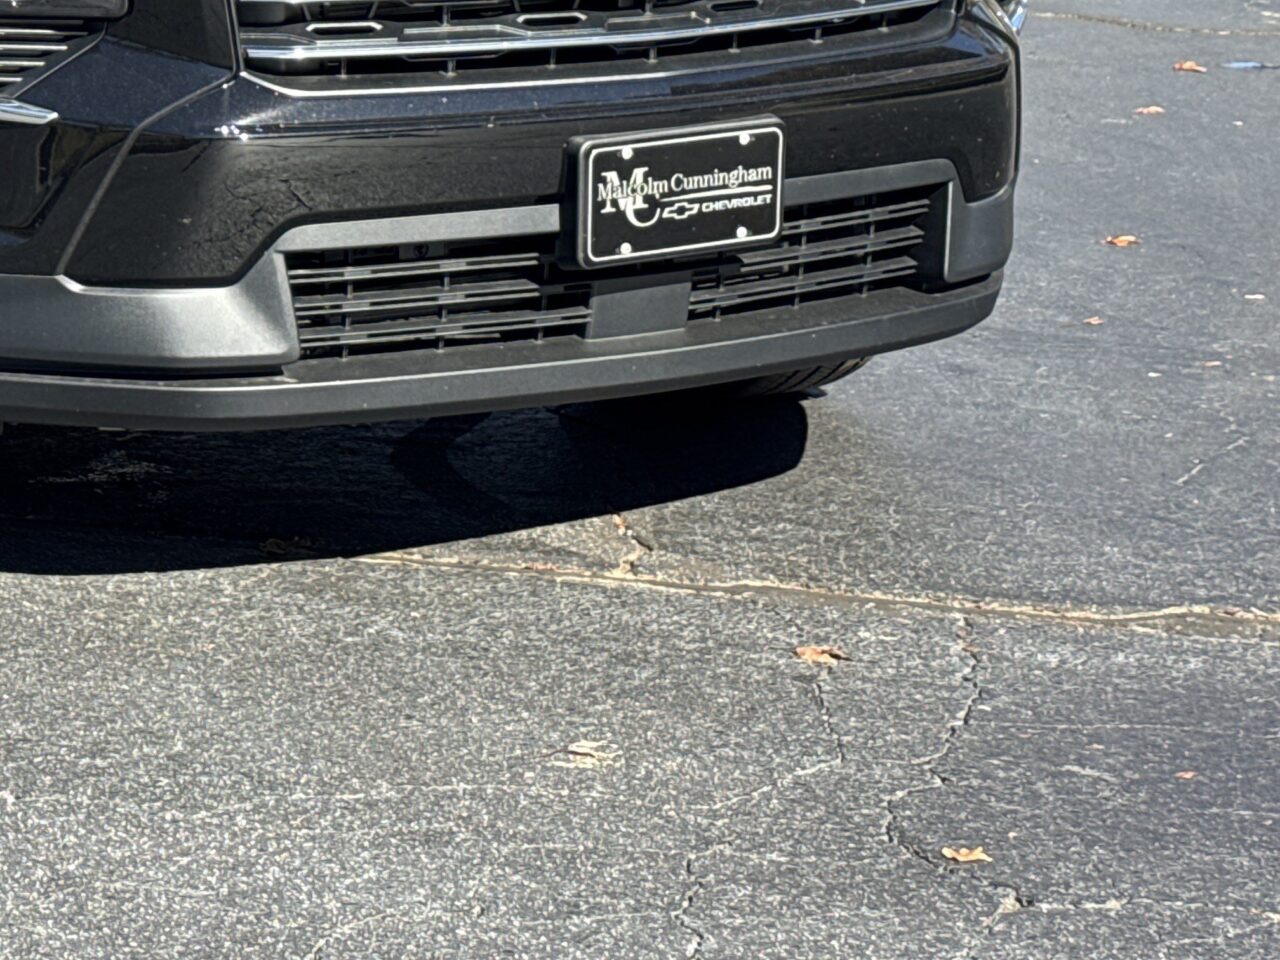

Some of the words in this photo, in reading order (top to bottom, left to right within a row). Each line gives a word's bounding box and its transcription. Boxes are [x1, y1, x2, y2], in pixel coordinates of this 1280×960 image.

[597, 176, 669, 202] Malcolm
[670, 164, 773, 192] Cunningham
[701, 193, 773, 213] CHEVROLET
